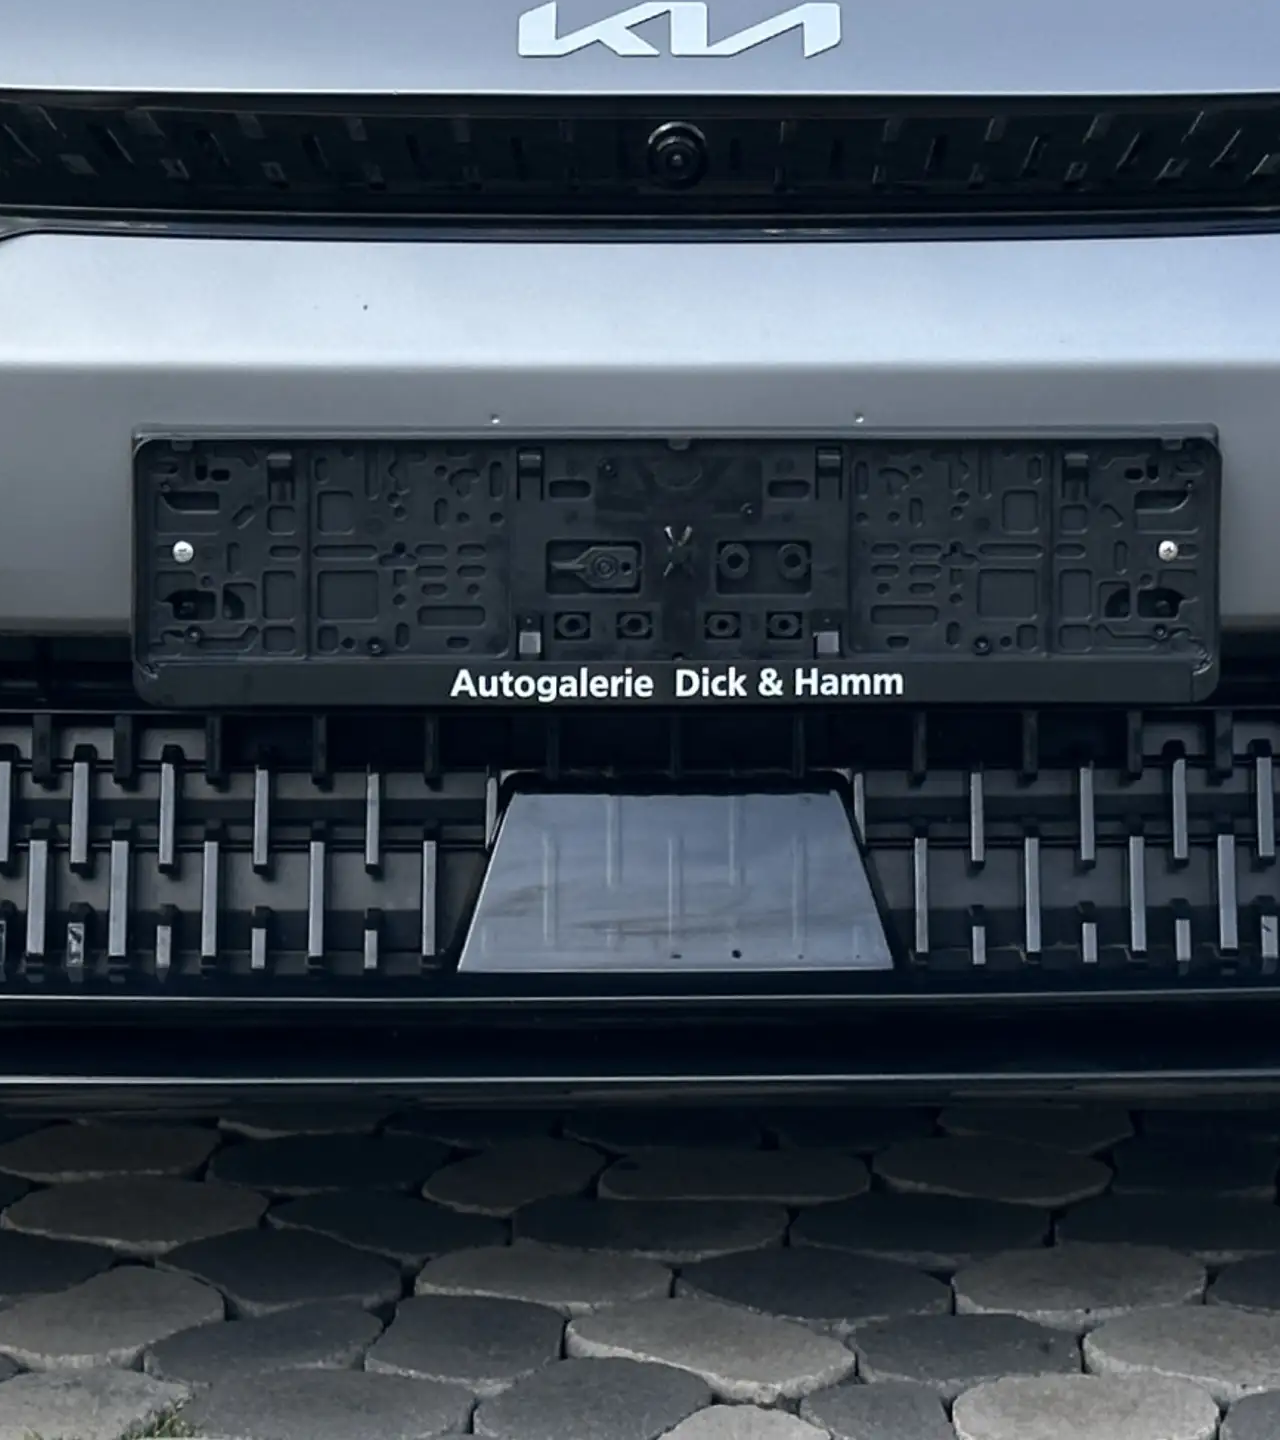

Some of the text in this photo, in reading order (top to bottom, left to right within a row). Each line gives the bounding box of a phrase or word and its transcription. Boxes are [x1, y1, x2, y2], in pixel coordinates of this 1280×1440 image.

[518, 0, 841, 59] KIA
[451, 667, 903, 702] Autogalerie Dick & Hamm
